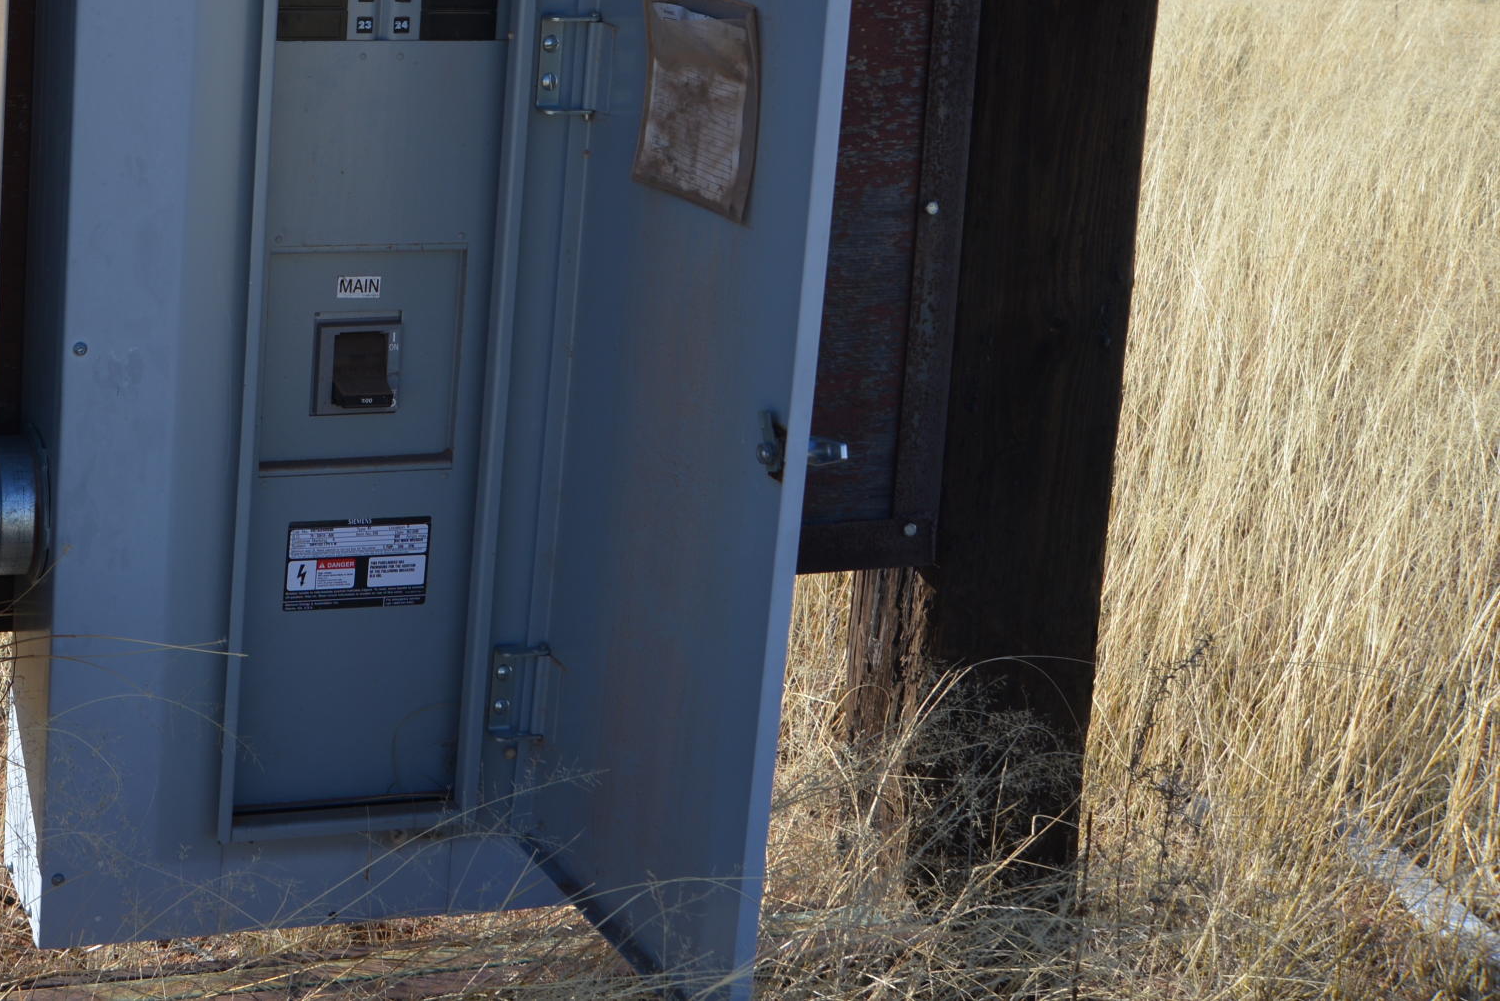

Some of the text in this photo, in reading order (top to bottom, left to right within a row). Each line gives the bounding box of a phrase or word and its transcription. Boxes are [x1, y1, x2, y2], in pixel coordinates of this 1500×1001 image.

[358, 20, 372, 30] 23
[395, 20, 409, 30] 24
[338, 278, 380, 294] MAIN
[388, 343, 399, 352] ON
[347, 518, 373, 526] SIEMENS
[327, 561, 356, 569] DANGER
